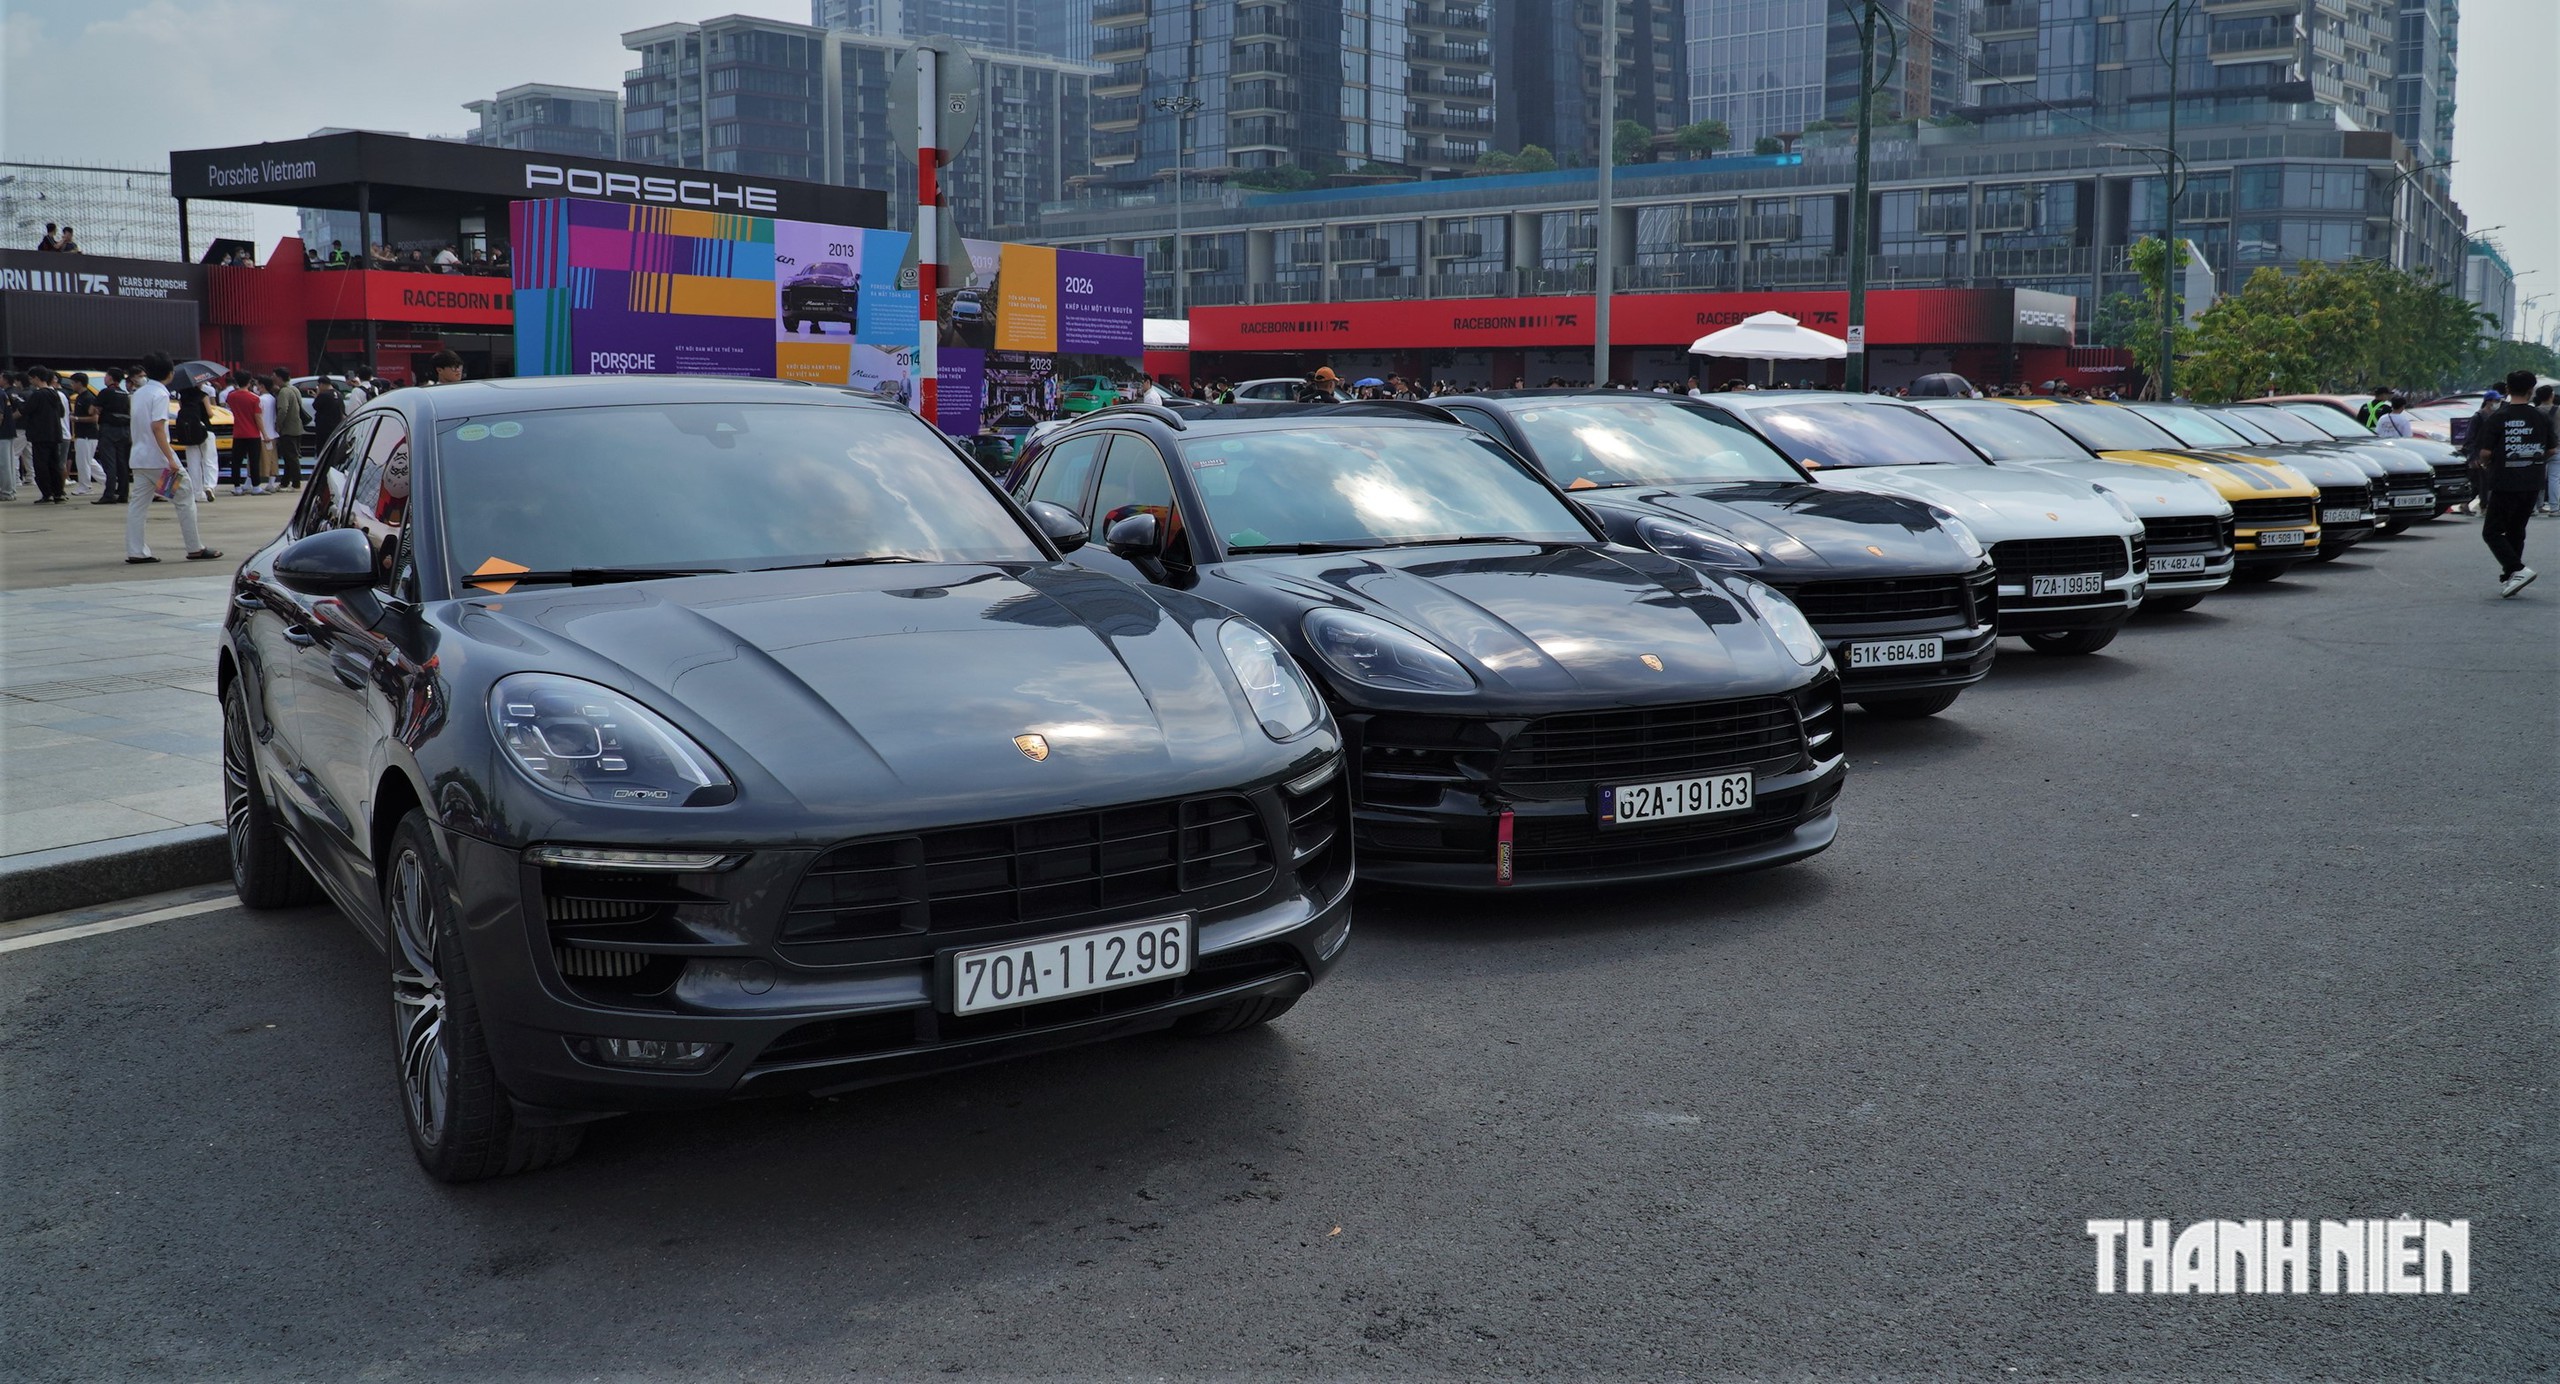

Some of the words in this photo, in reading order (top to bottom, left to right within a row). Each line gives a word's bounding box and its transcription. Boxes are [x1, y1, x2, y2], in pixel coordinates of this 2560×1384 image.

[208, 162, 259, 187] Porsche
[261, 160, 316, 183] Vietnam
[525, 163, 777, 212] PORSCHE
[828, 243, 854, 258] 2013
[972, 255, 993, 269] 2019
[79, 273, 110, 295] 75
[118, 275, 142, 288] YEARS
[143, 277, 153, 288] OF
[155, 278, 188, 290] PORSCHE
[1065, 276, 1094, 295] 2026
[118, 287, 168, 298] MOTORSPORT
[403, 289, 490, 310] RACEBORN
[1453, 316, 1516, 330] RACEBORN
[1555, 314, 1578, 327] 75
[1813, 311, 1838, 324] 75
[2020, 309, 2065, 328] PORSCHE
[1240, 321, 1296, 334] RACEBORN
[1330, 320, 1349, 332] 75
[590, 351, 656, 370] PORSCHE
[896, 353, 920, 366] 2014
[1030, 358, 1052, 371] 2023
[2505, 420, 2525, 428] NEED
[2505, 428, 2534, 436] MONEY
[2505, 443, 2541, 452] PORSCHE
[2261, 532, 2301, 545] 51K-509.11
[2149, 557, 2200, 571] 51K-482.44
[2034, 576, 2100, 596] 72A-199.55
[1853, 642, 1935, 664] 51K-684.88
[1604, 790, 1611, 798] D
[1619, 776, 1748, 820] 62A-191.63
[965, 926, 1180, 1006] 70A-112.96
